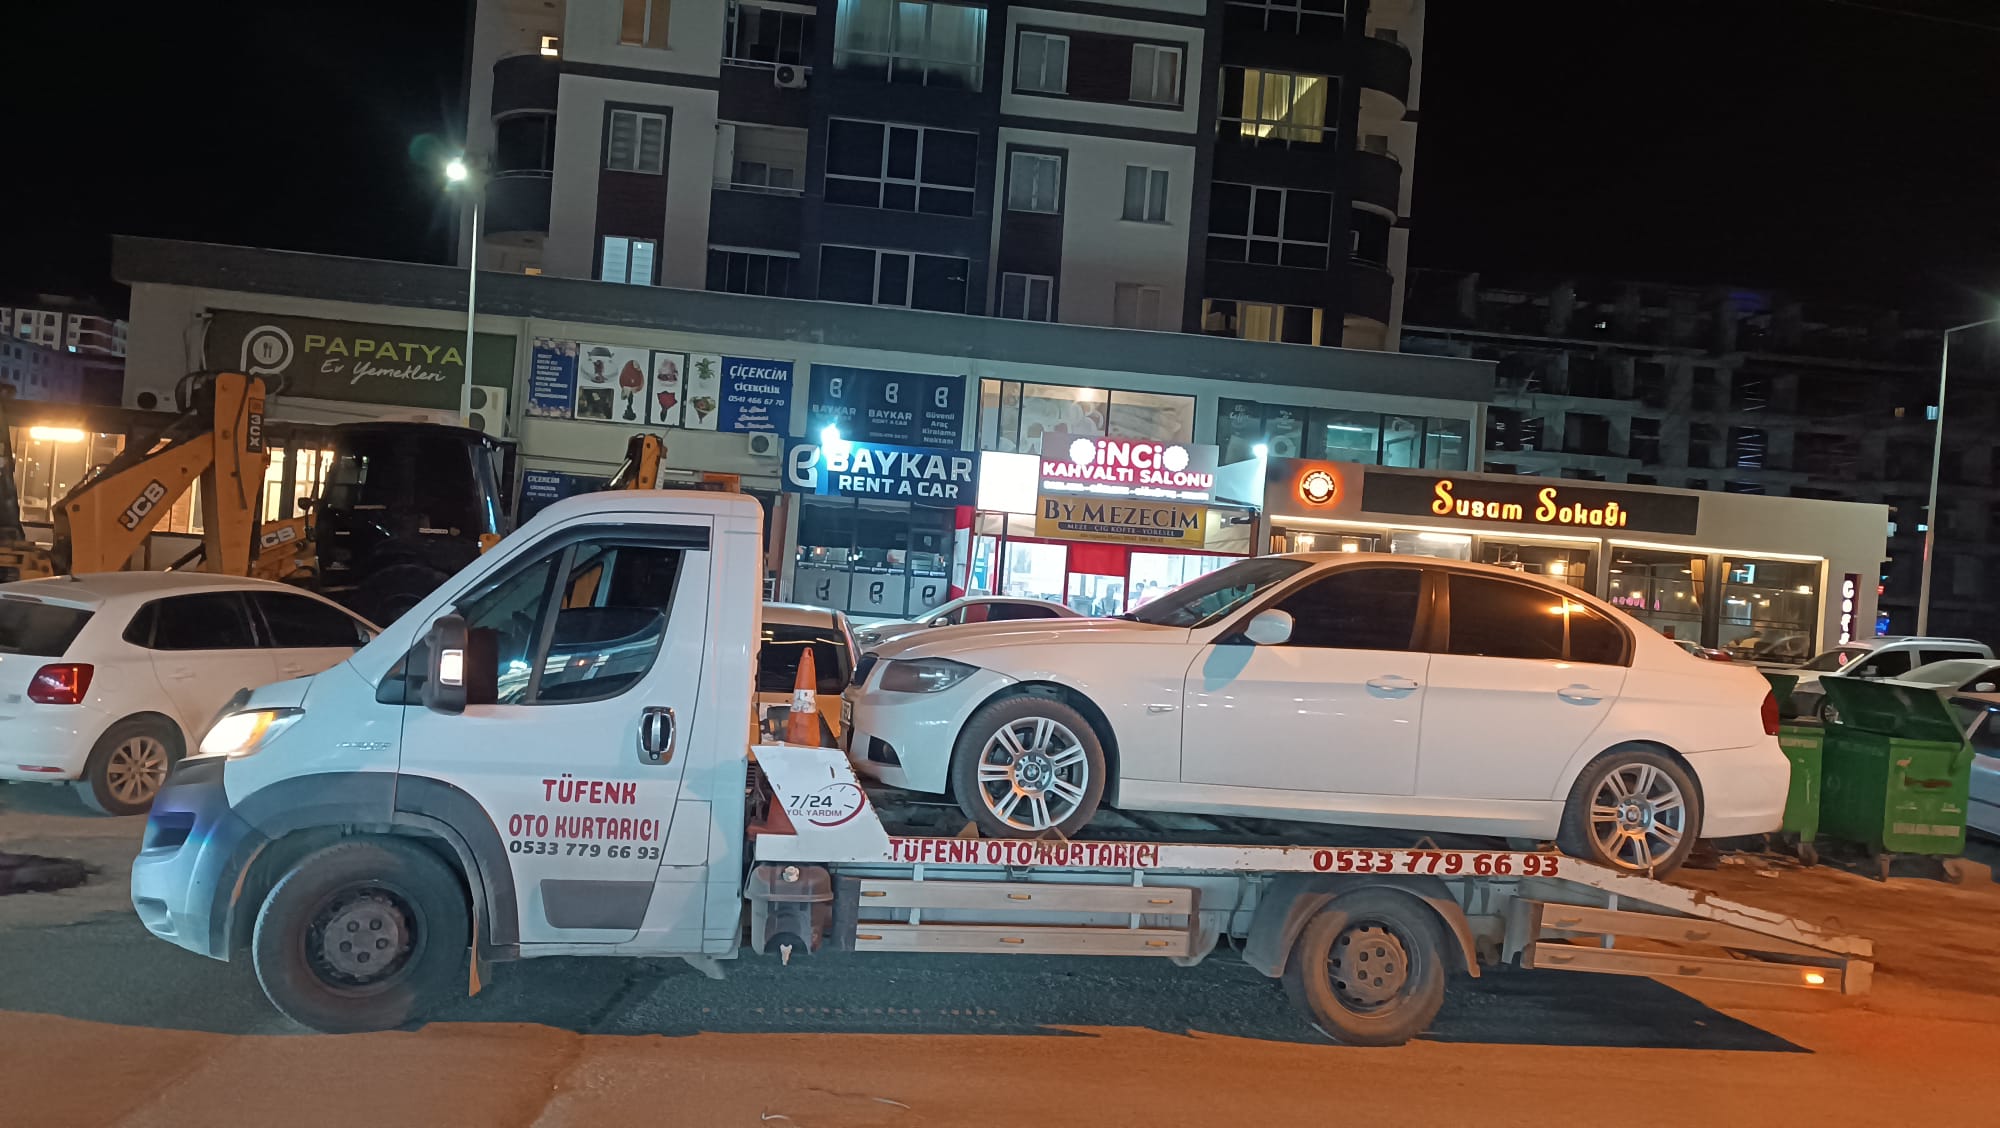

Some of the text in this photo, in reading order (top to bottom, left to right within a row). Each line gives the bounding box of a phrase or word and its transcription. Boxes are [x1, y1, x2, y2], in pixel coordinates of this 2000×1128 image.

[304, 334, 464, 367] PAPATYA
[320, 358, 447, 385] Ev Yemekleri
[868, 408, 912, 421] BAYKAR
[250, 414, 261, 447] 3CX
[826, 446, 972, 482] BAYKAR
[1042, 461, 1213, 488] KAHVALTI SALONU
[838, 475, 959, 499] RENT A CAR
[125, 482, 166, 529] JCB
[1431, 480, 1627, 527] Susam Sokağı
[260, 526, 296, 549] CB
[542, 773, 637, 805] TÜFENK
[790, 794, 833, 809] 7/24
[786, 808, 843, 817] YOL YARDIM
[508, 814, 660, 842] OTO KURTARICI
[509, 840, 660, 860] 0533 779 66 93
[889, 838, 1159, 867] TÜFENK OTO KURTARICI
[1313, 850, 1559, 877] 0533 779 66 93
